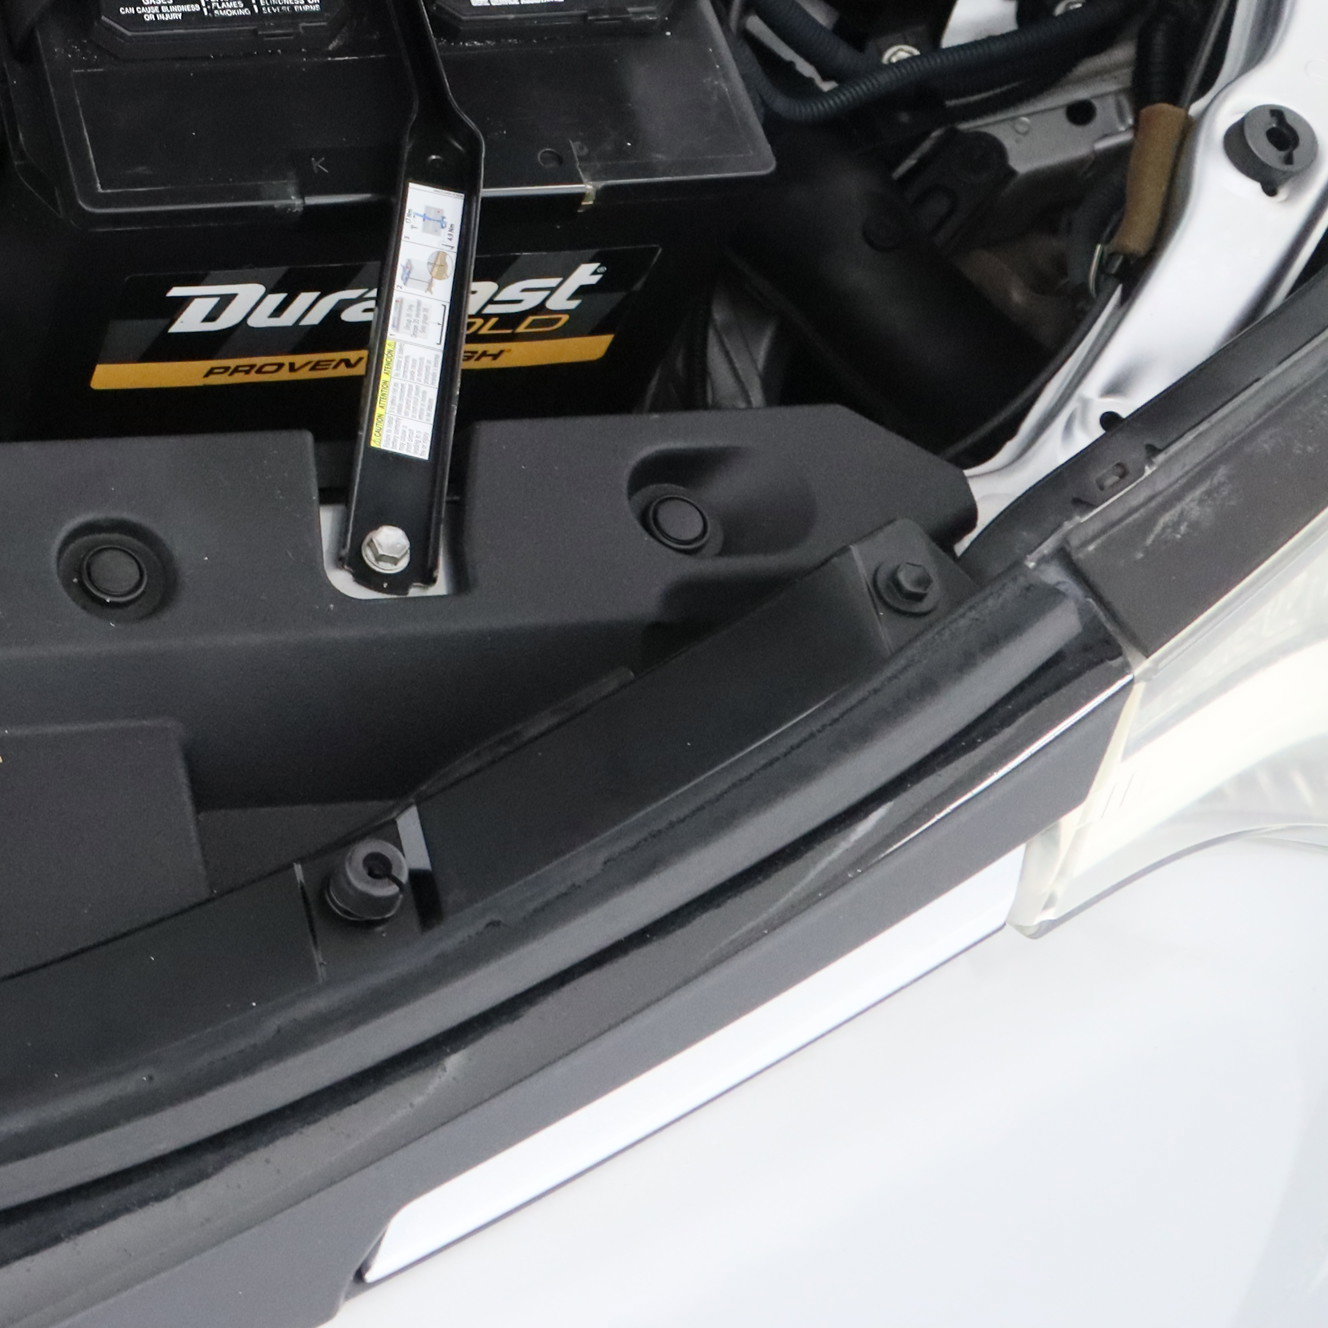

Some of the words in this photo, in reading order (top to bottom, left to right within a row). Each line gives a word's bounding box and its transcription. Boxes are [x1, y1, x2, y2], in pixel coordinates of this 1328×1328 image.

[136, 5, 159, 14] CAUSE
[161, 4, 200, 12] BLINDNESS
[144, 13, 155, 21] OR
[311, 157, 329, 173] K
[166, 263, 600, 333] Durast
[203, 357, 364, 379] PROVEN
[374, 413, 383, 438] CAUTION
[381, 380, 390, 410] ATTENTION
